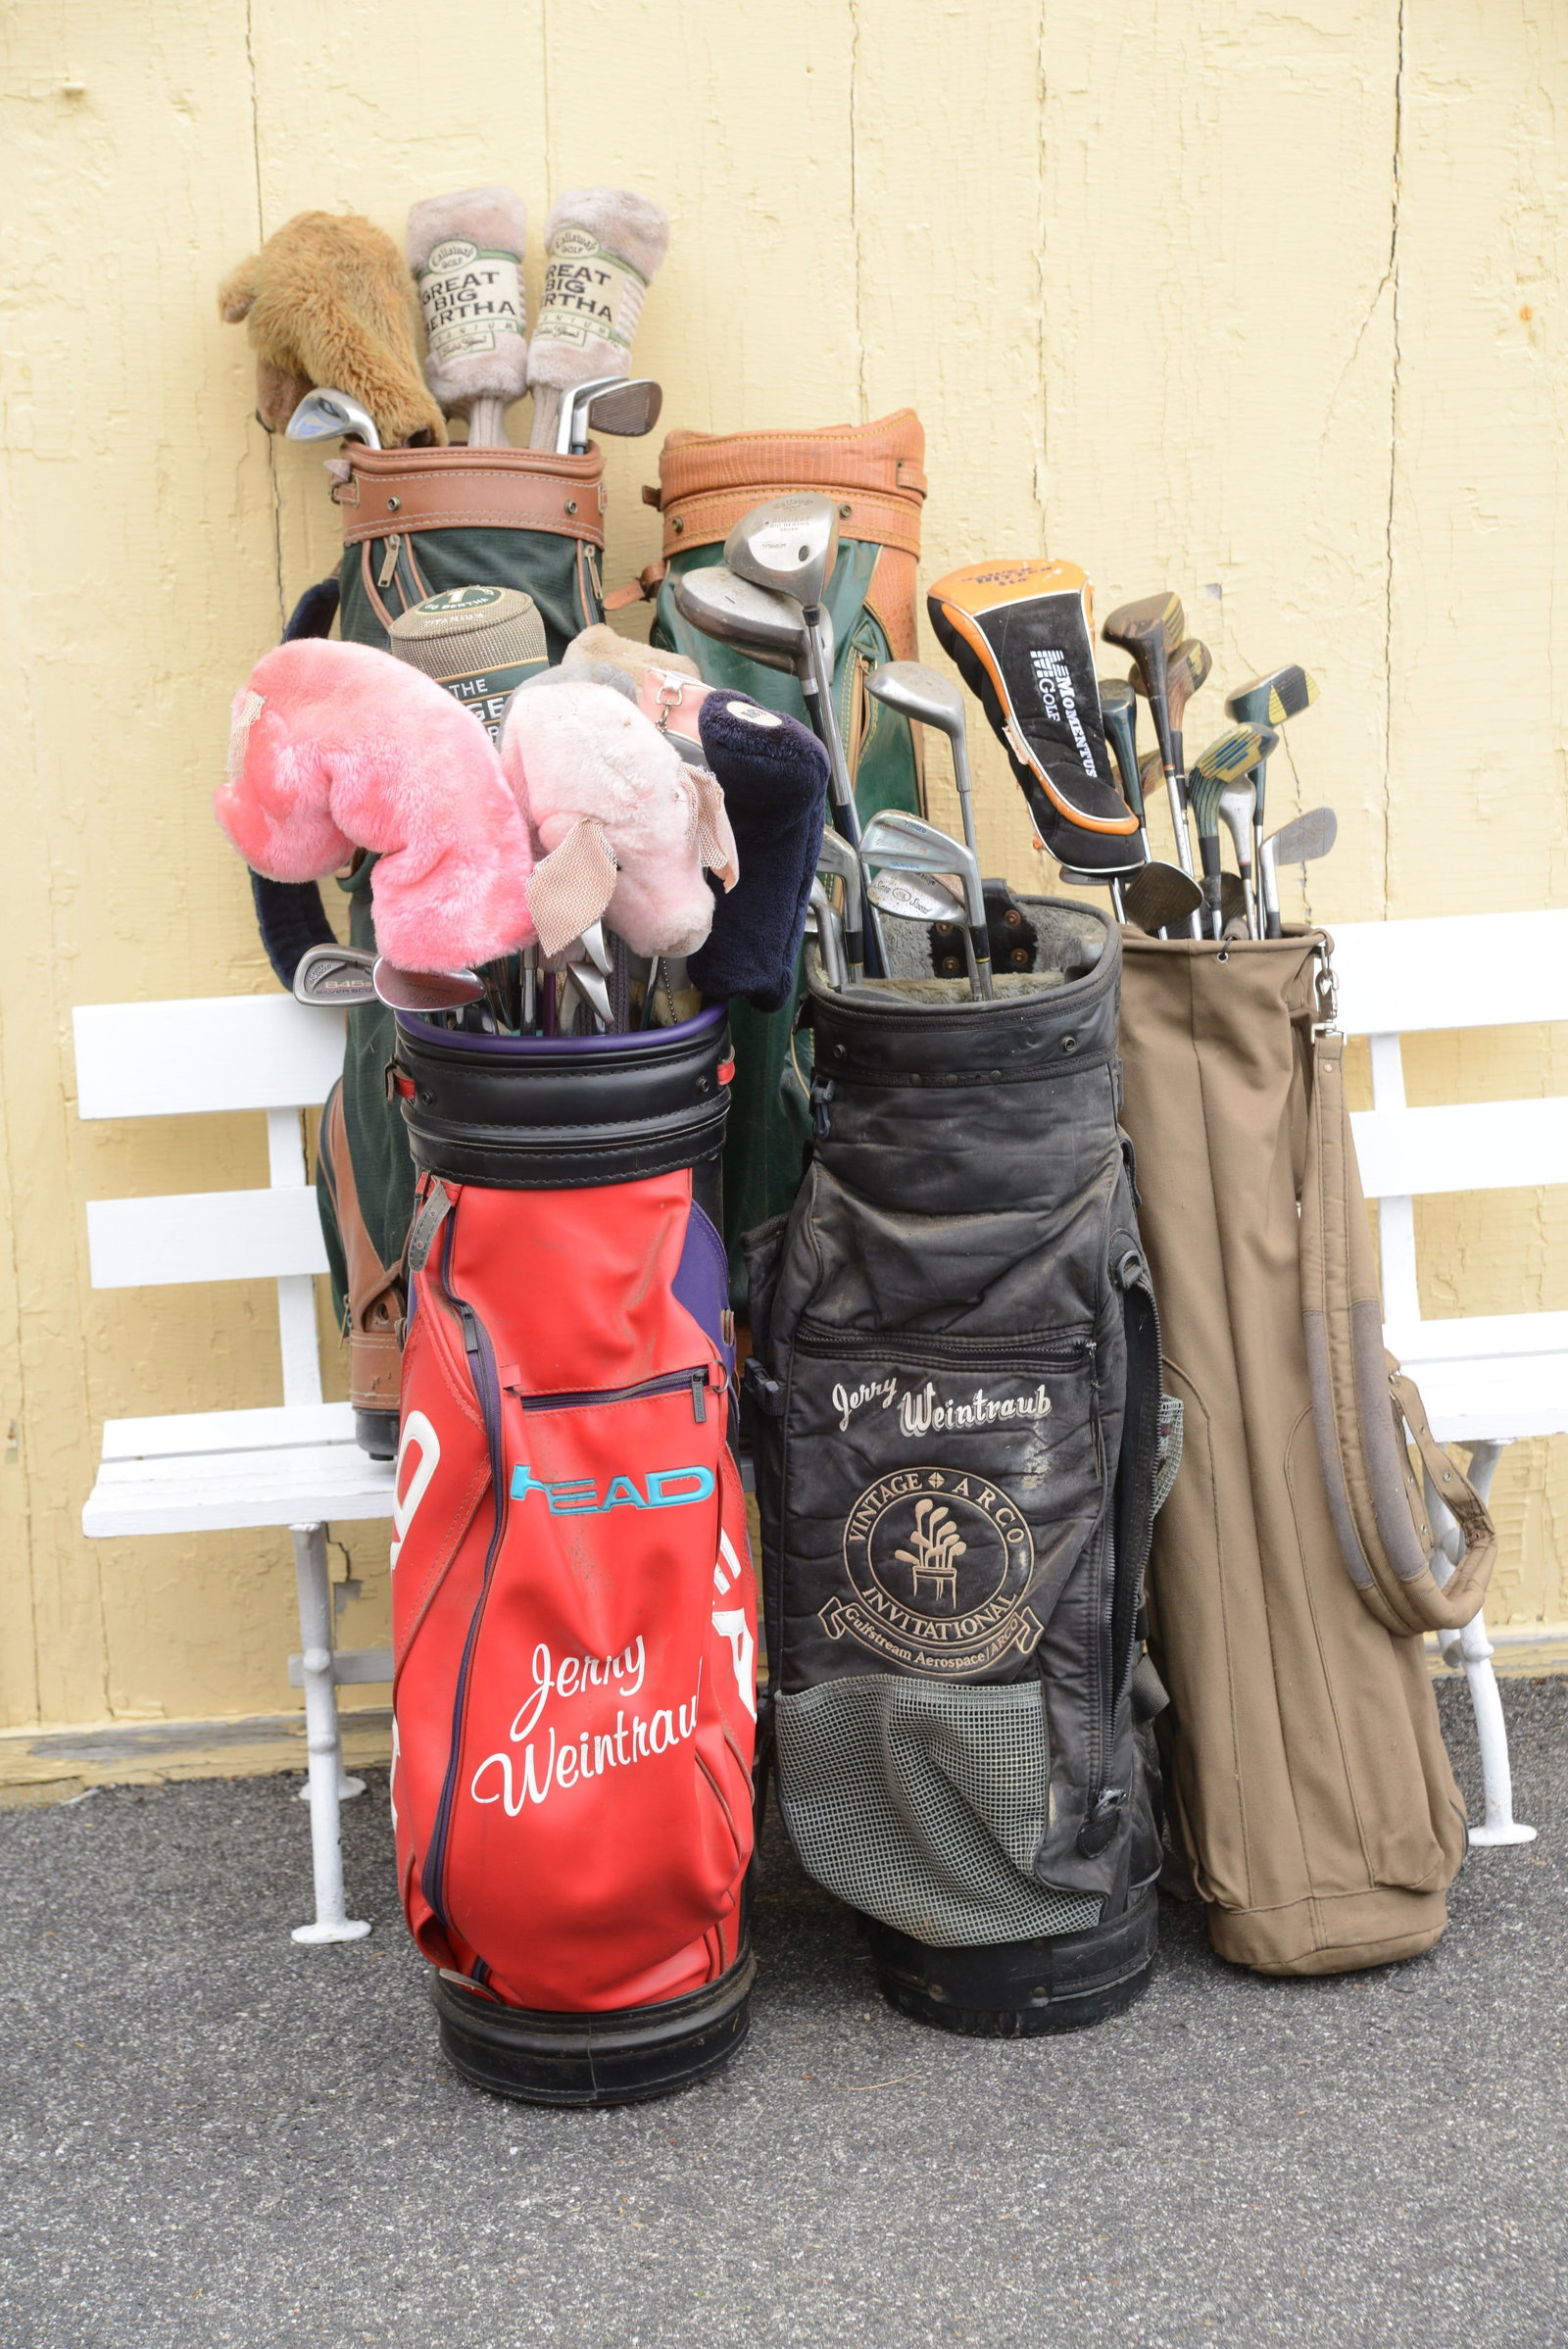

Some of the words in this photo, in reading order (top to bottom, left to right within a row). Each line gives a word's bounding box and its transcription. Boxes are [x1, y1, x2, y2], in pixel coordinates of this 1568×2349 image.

[441, 258, 463, 269] GOLF
[562, 245, 583, 254] GOLF
[422, 271, 500, 306] GREAT
[545, 277, 586, 294] BIG
[546, 263, 612, 286] REAT
[434, 289, 477, 312] BIG
[544, 292, 612, 322] RTHA
[448, 678, 488, 699] THE
[1039, 677, 1061, 722] GOLF
[1056, 674, 1097, 778] MOMENTUS
[832, 1377, 897, 1433] Jerry
[898, 1382, 1052, 1438] Weintraub
[511, 1464, 716, 1516] HEAD
[849, 1473, 923, 1542] VINTAGE
[952, 1477, 1025, 1544] ARCO
[861, 1586, 1018, 1640] INVITATIONAL
[845, 1607, 912, 1660] Gulfstream
[470, 1695, 700, 1817] Weintrau
